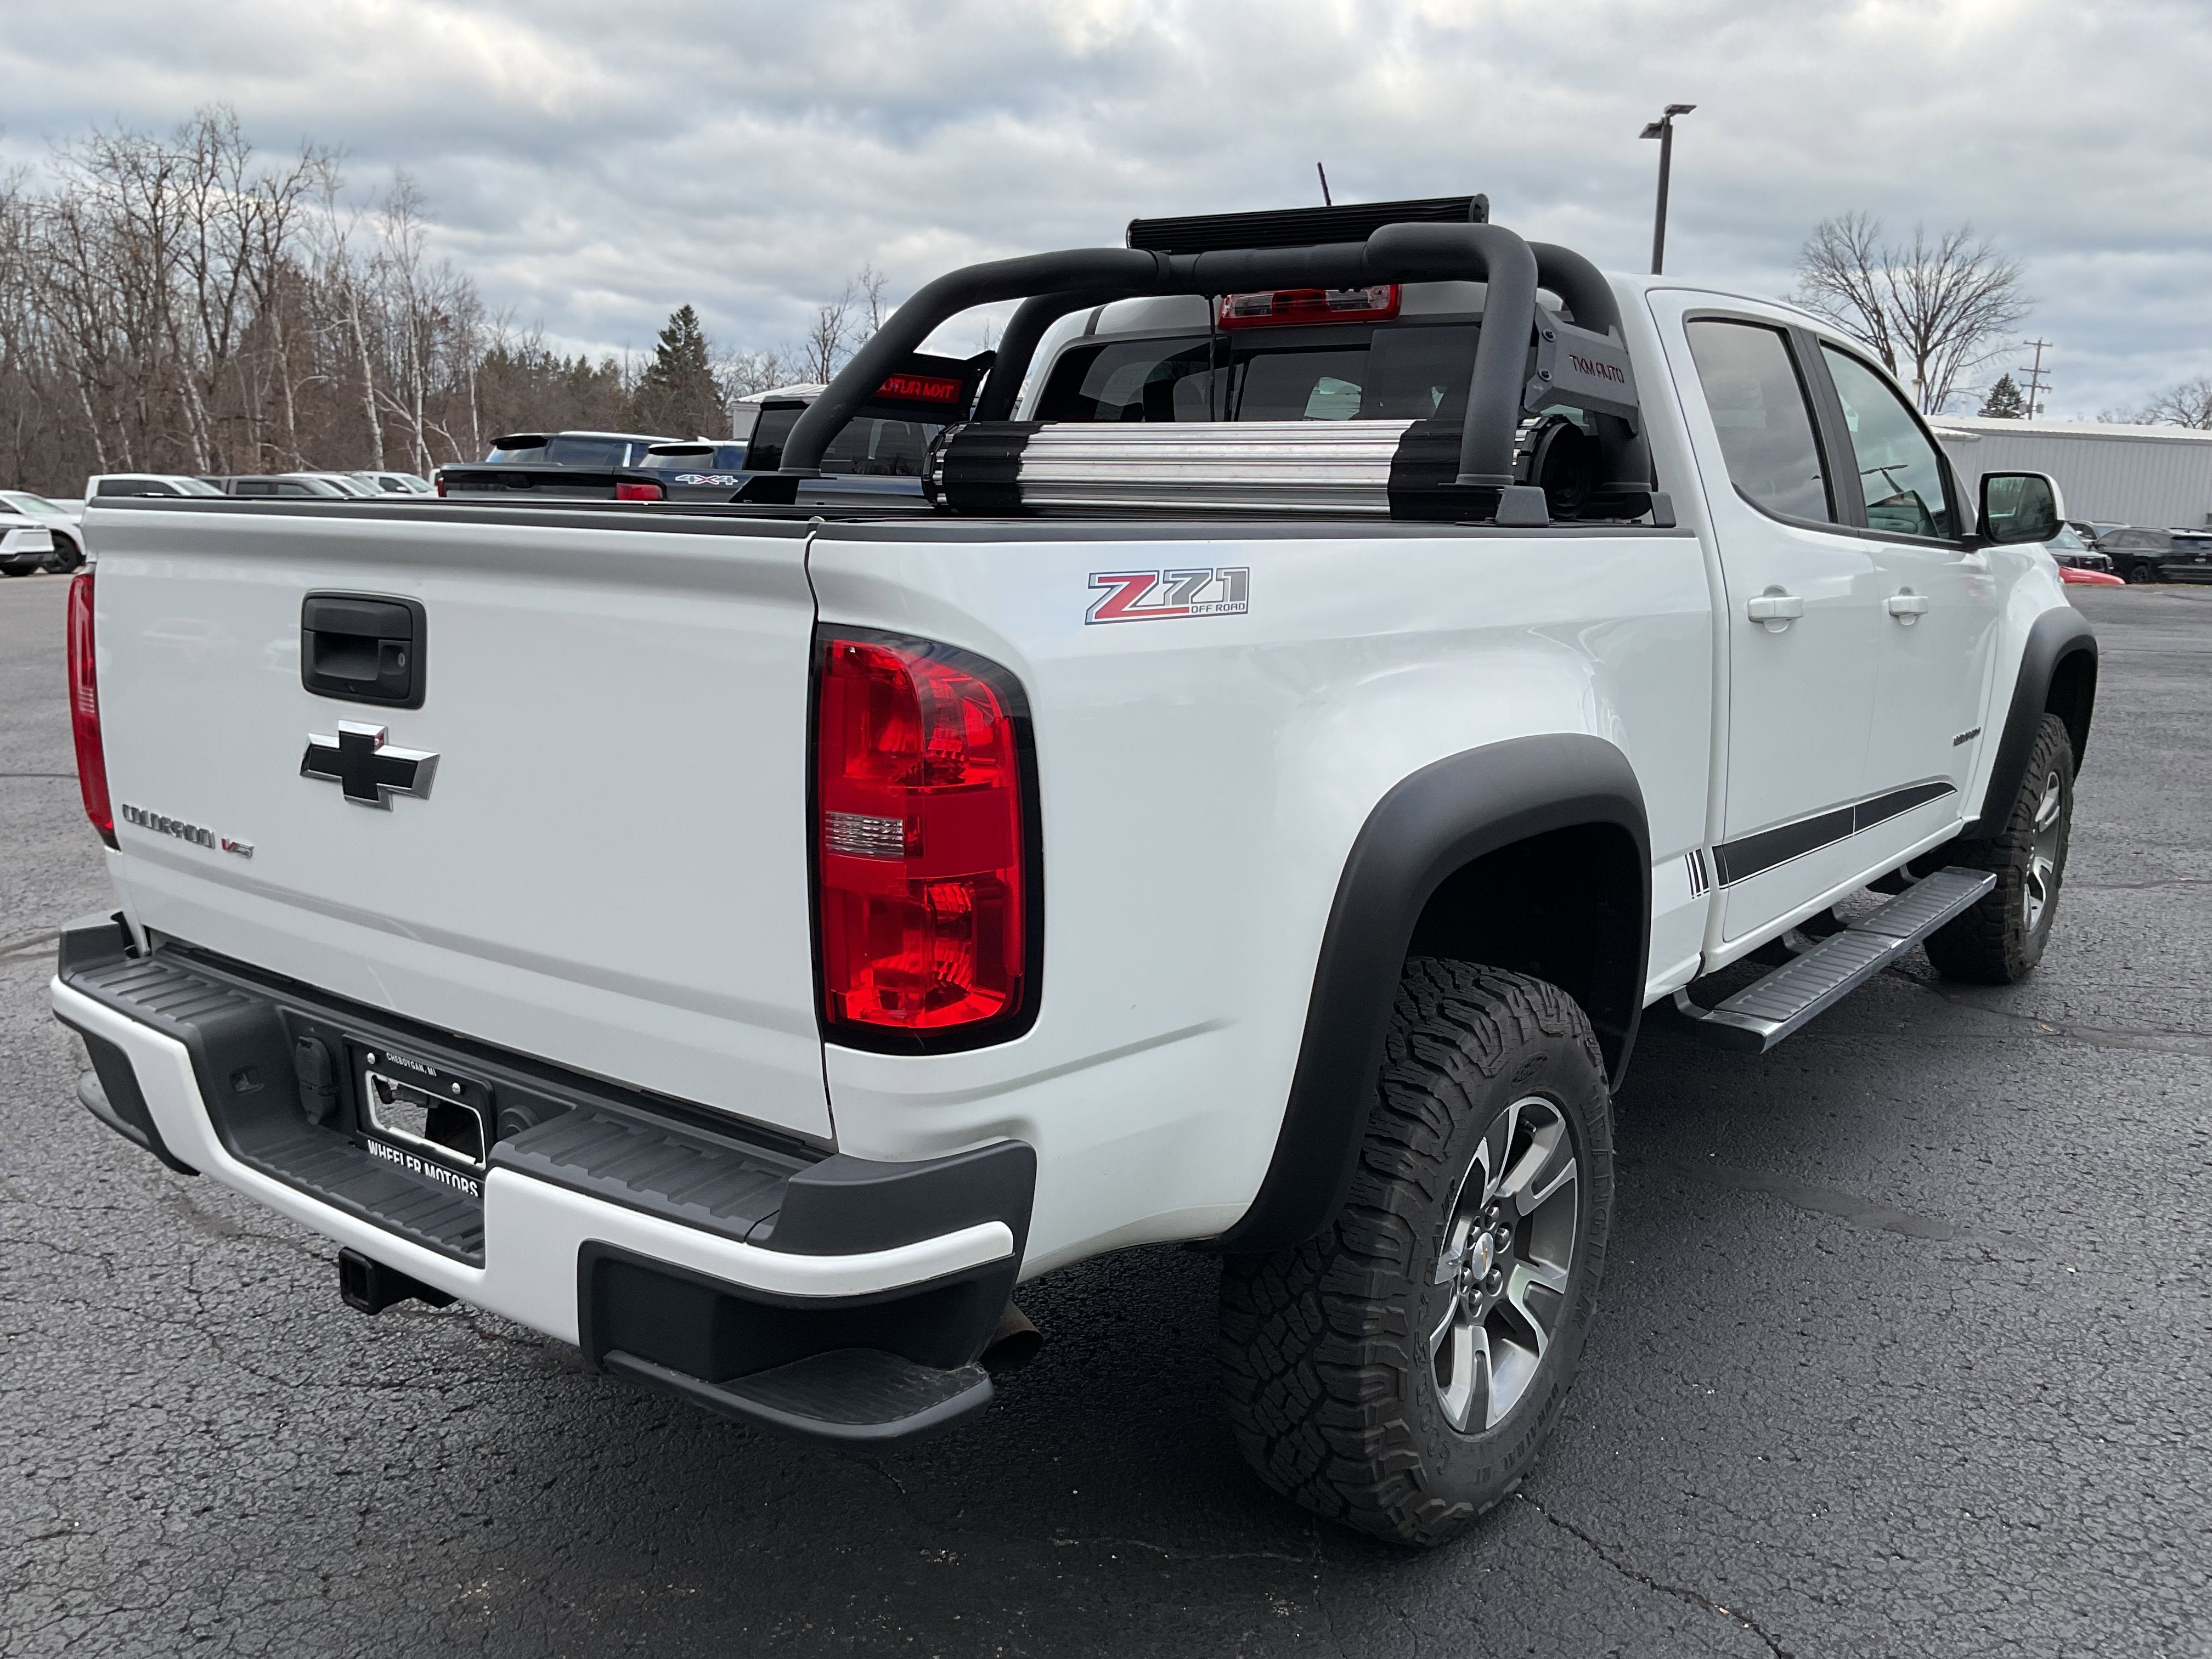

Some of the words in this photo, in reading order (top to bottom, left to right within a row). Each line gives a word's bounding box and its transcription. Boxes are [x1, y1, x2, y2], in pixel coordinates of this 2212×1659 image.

[1569, 354, 1595, 376] TKM
[1595, 362, 1624, 383] AUTO
[1085, 567, 1250, 625] Z71
[1216, 603, 1245, 612] ROAD
[427, 1066, 437, 1076] MI
[368, 1139, 421, 1173] WHEELER
[424, 1163, 478, 1197] MOTORS
